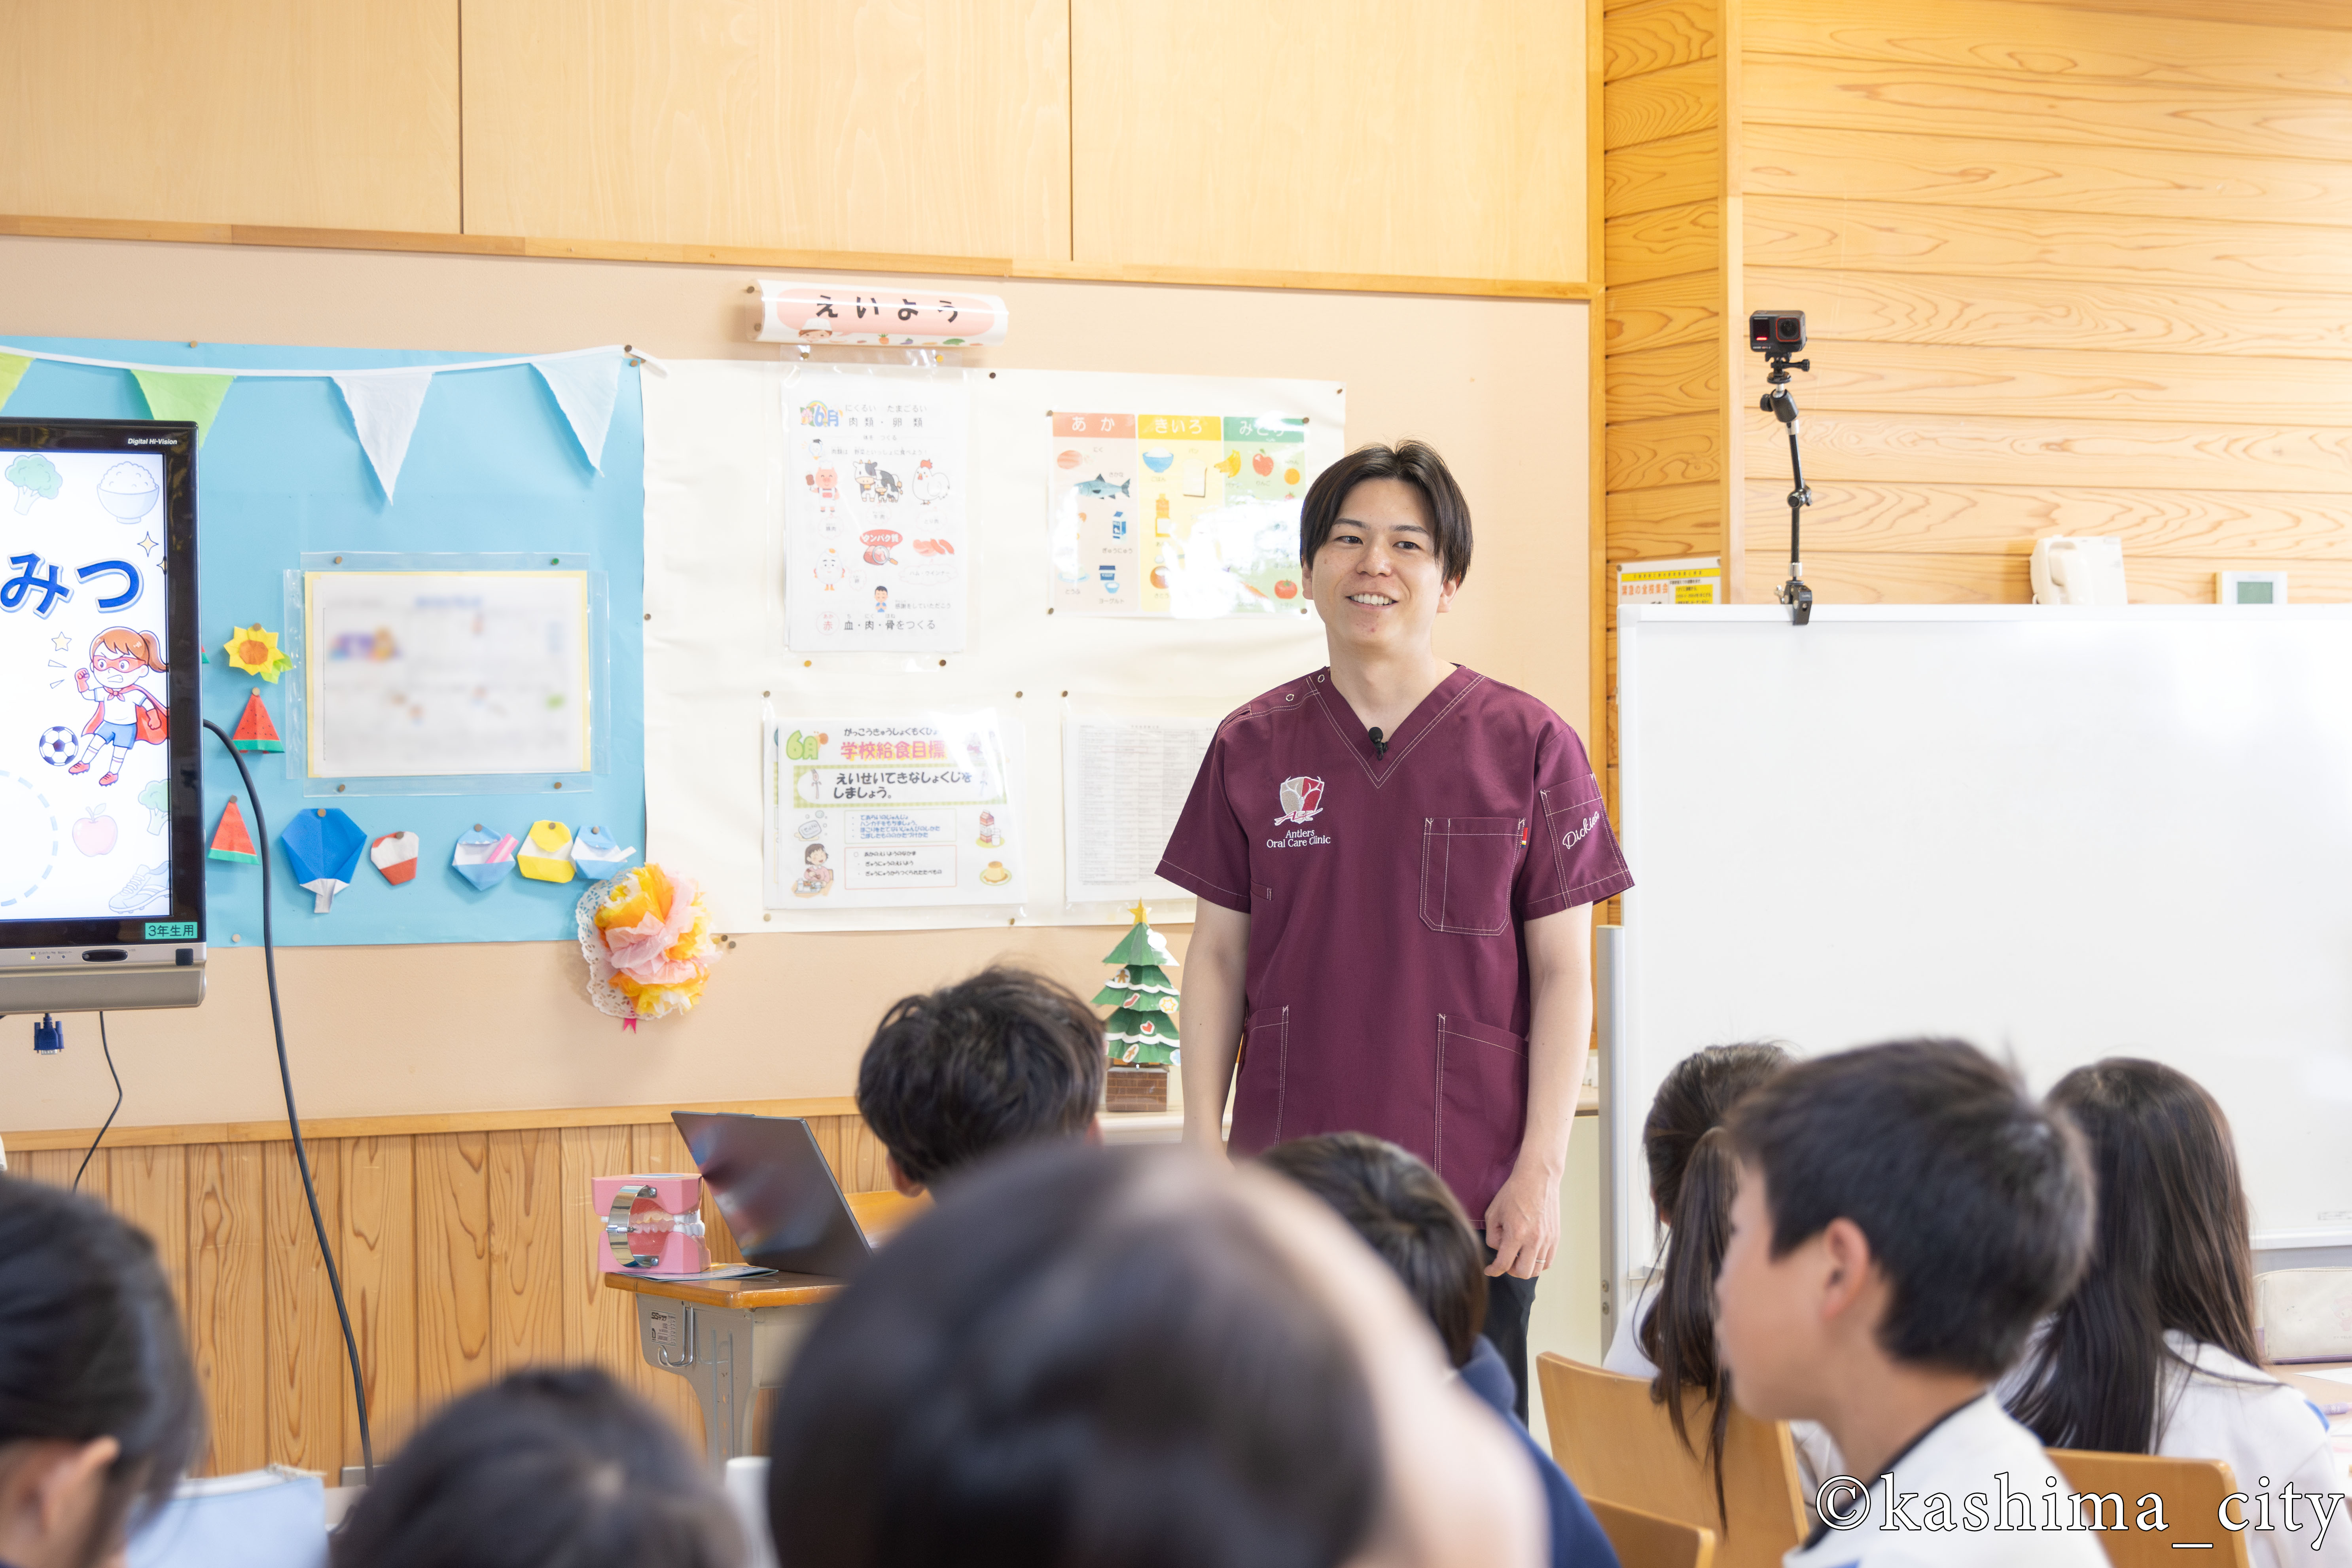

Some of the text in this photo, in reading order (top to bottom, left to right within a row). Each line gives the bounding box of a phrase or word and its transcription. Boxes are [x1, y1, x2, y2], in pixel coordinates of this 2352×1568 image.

[816, 295, 958, 323] えいよう
[814, 404, 839, 427] 6月
[1072, 416, 1115, 432] あか
[1155, 418, 1202, 434] きいろ
[786, 729, 818, 760] 6月
[840, 740, 948, 761] 学校給食目標
[1285, 829, 1315, 838] Antlers
[1562, 811, 1600, 850] Dickies
[1266, 835, 1331, 848] Oral Care Clinic
[148, 924, 193, 937] 3年生用
